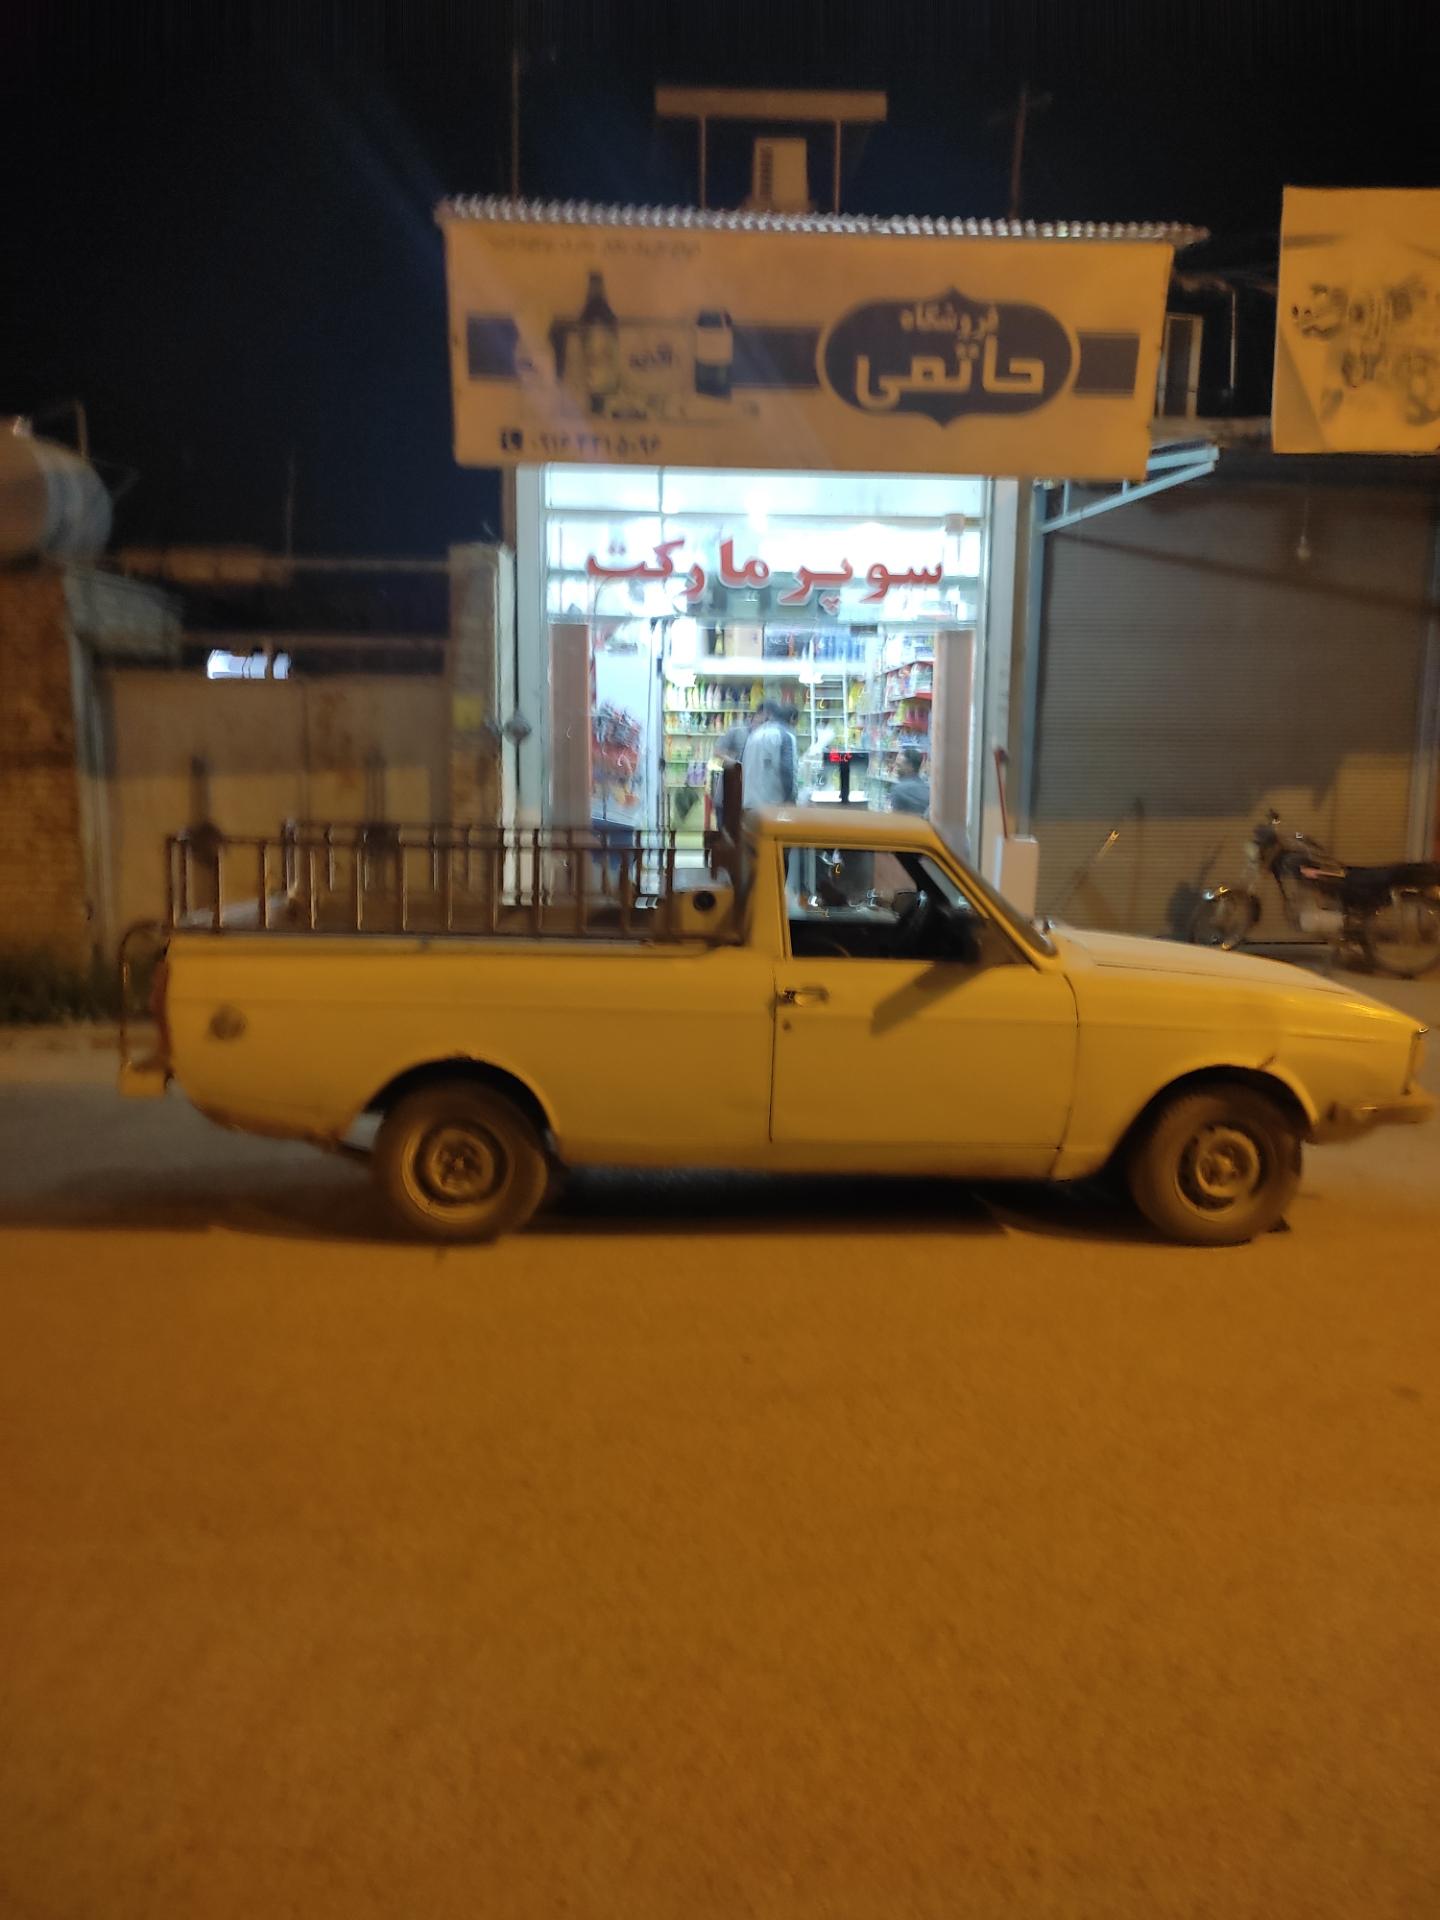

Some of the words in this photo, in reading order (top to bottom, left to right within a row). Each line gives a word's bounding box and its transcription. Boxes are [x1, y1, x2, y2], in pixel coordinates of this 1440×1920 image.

[899, 301, 999, 341] فروشگاه
[856, 334, 1045, 411] حاتمی
[584, 536, 771, 604] مارکت
[778, 555, 946, 614] سوپر
